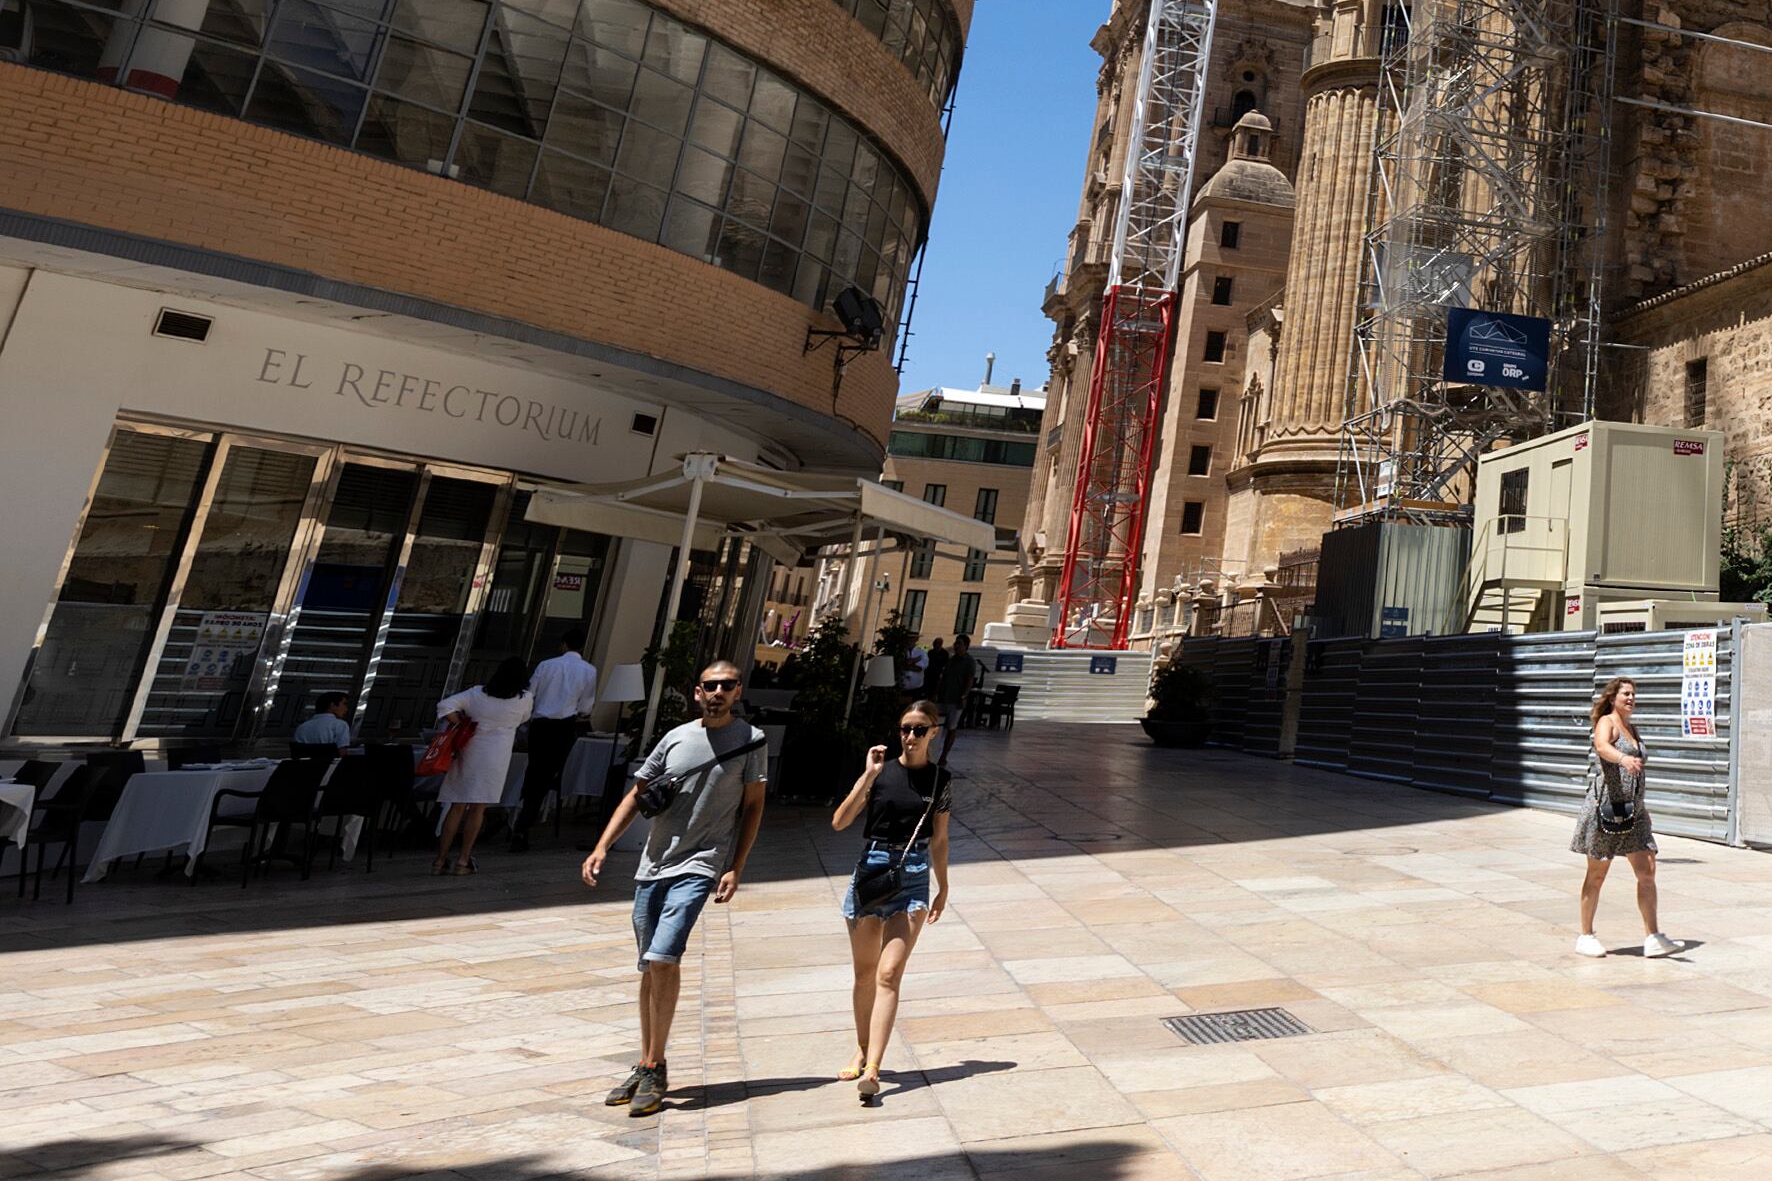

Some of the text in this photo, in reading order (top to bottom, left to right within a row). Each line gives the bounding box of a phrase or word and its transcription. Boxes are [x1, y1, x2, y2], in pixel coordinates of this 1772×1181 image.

[1502, 368, 1523, 378] ORP
[256, 348, 602, 446] EL REFECTORIUM
[1675, 440, 1703, 451] REMSA
